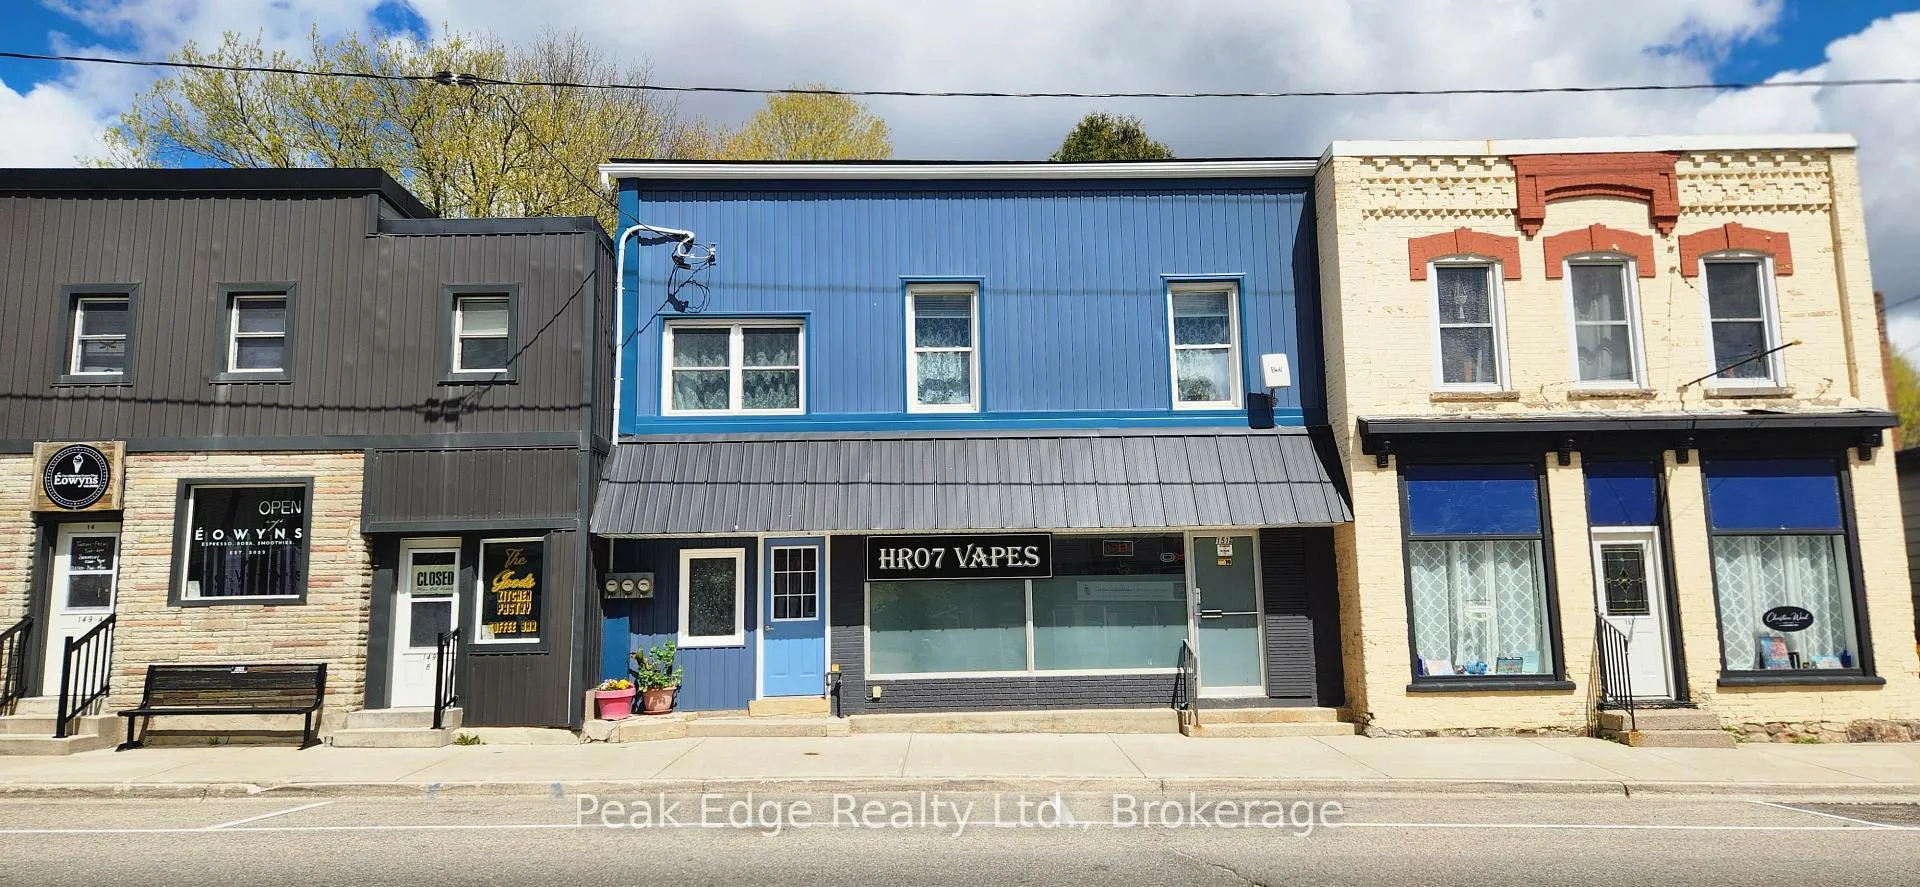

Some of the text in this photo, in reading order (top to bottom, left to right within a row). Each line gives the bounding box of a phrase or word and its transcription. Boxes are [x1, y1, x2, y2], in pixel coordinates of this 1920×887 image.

[53, 472, 99, 488] Éowyns
[258, 500, 302, 515] OPEN
[195, 527, 303, 541] ÉOWYNS
[504, 547, 528, 568] The
[952, 542, 1041, 569] VAPES
[416, 571, 455, 586] CLOSED
[497, 590, 532, 602] KITCHEN
[497, 602, 532, 615] PASTRY
[520, 620, 537, 632] BAR
